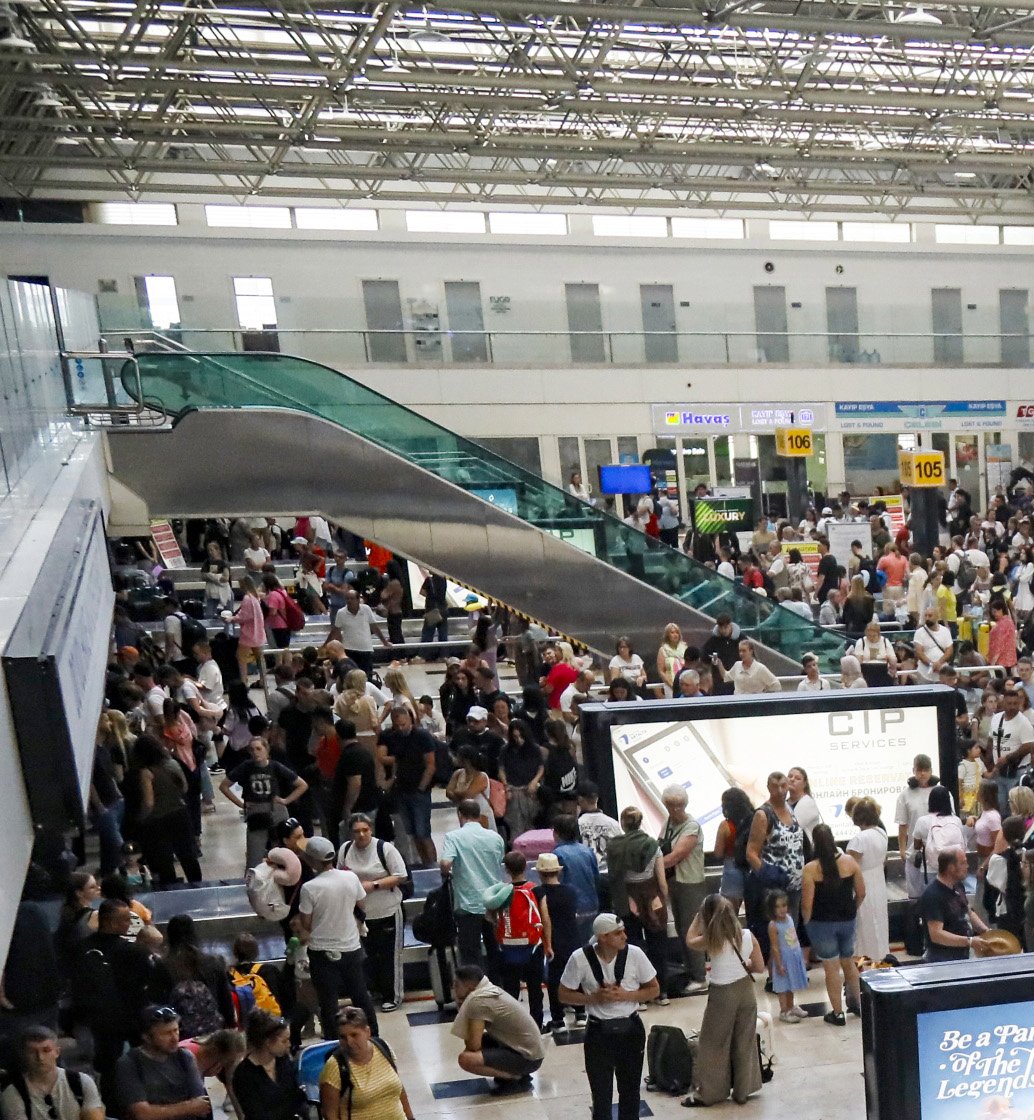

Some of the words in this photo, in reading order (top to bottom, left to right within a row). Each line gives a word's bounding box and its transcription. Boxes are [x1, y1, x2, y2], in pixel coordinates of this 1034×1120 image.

[682, 413, 730, 428] Havaş
[787, 434, 811, 449] 106
[915, 461, 942, 478] 105
[827, 708, 905, 736] CIP
[829, 737, 907, 751] SERVICES
[851, 785, 910, 796] БРОНИРОВА
[940, 1030, 973, 1051] Be
[976, 1032, 991, 1047] a
[949, 1051, 981, 1076] of
[976, 1049, 1021, 1077] The
